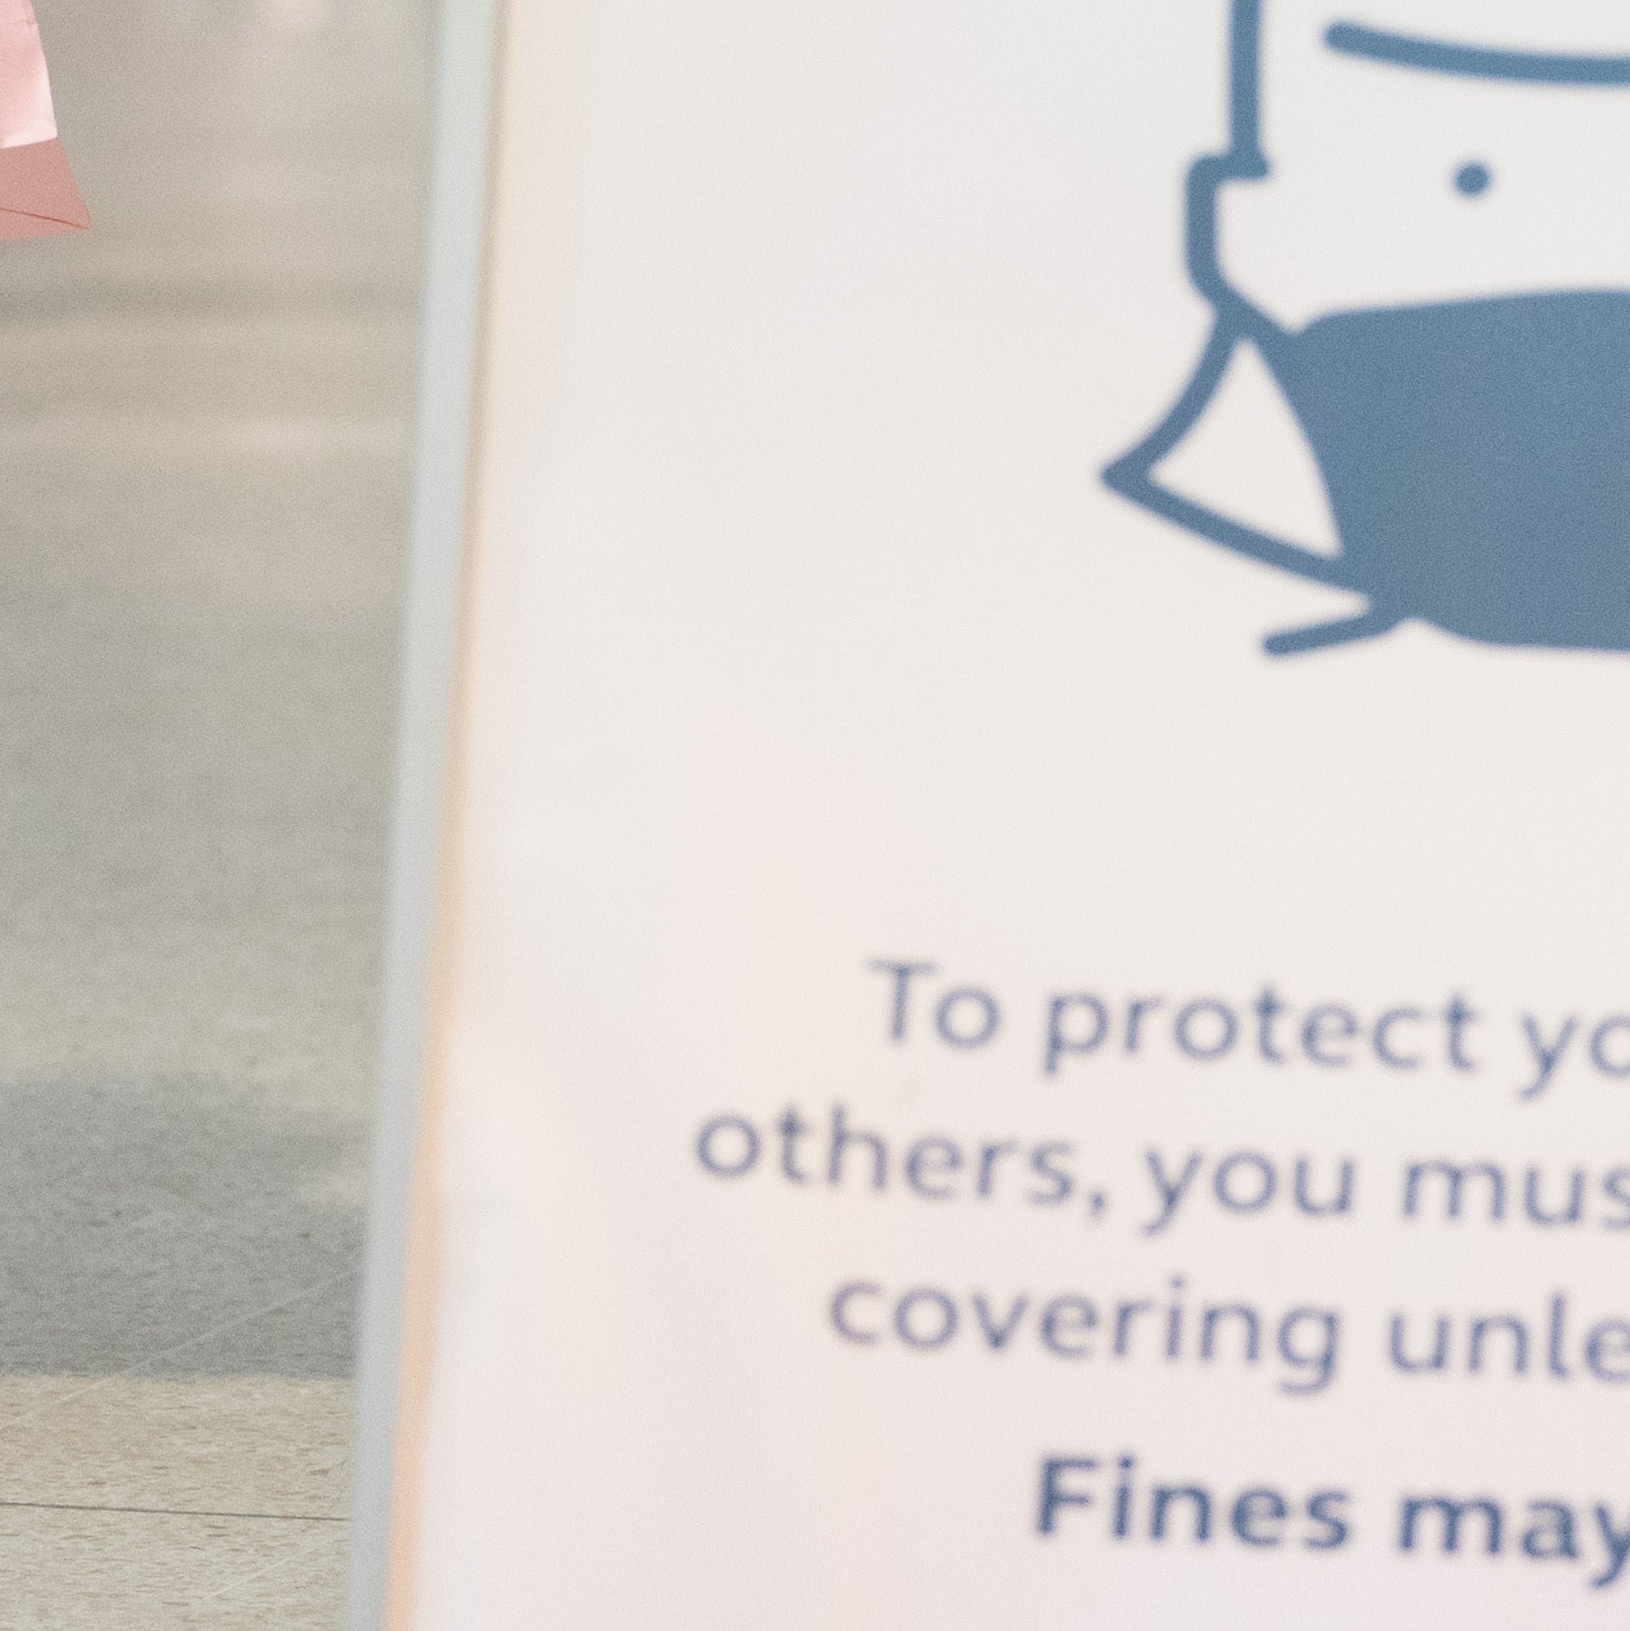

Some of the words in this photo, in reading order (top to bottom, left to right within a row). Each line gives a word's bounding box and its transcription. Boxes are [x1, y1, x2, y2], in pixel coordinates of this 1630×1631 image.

[871, 959, 1003, 1051] To
[1042, 986, 1477, 1077] protect
[692, 1104, 1108, 1218] others,
[1143, 1150, 1357, 1237] you
[828, 1276, 1342, 1397] covering
[1035, 1454, 1352, 1552] Fines
